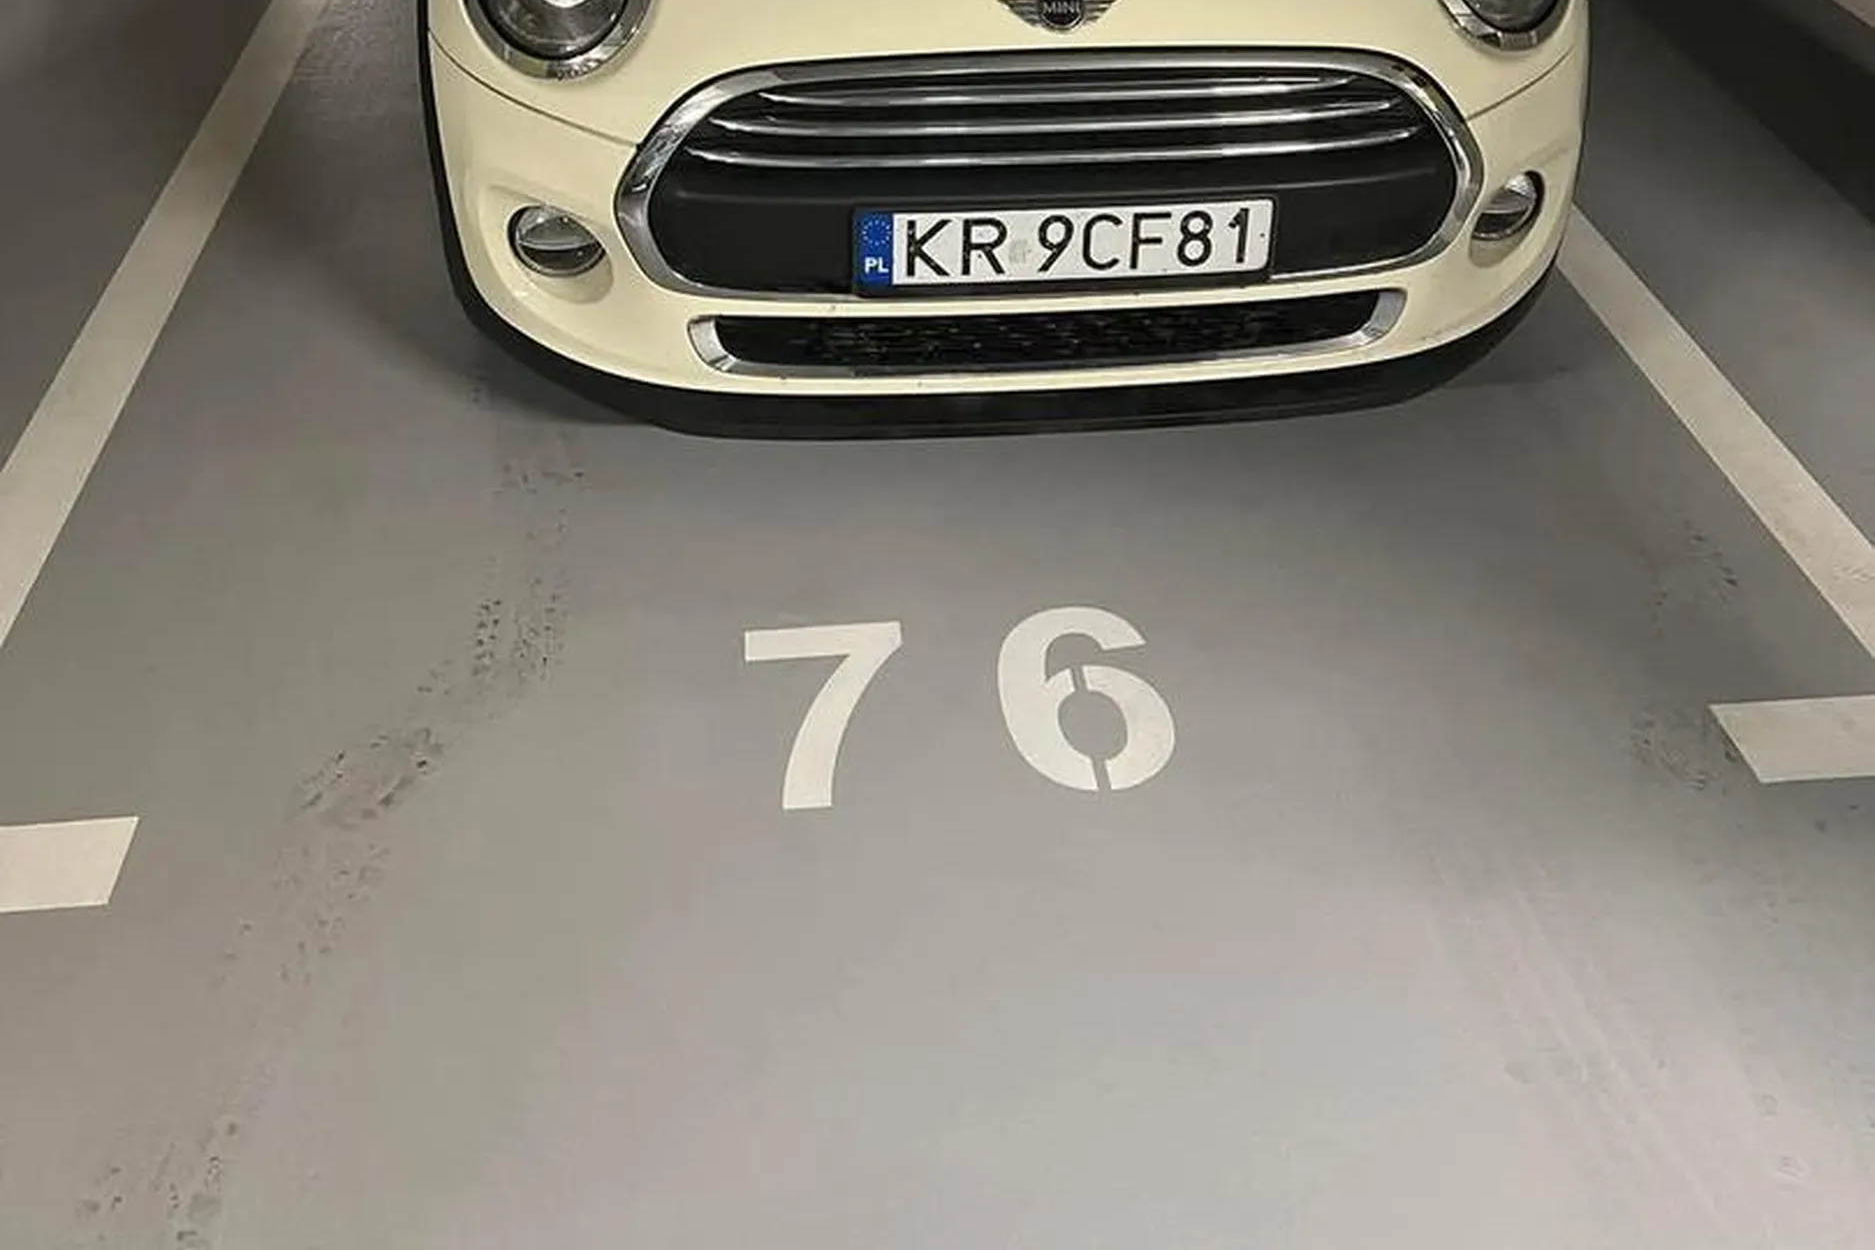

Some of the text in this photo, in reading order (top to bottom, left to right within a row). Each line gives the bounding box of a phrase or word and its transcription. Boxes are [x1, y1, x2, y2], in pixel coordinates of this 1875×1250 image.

[1042, 1, 1081, 14] MINI
[905, 207, 1251, 277] KR 9CF81
[864, 257, 890, 274] PL
